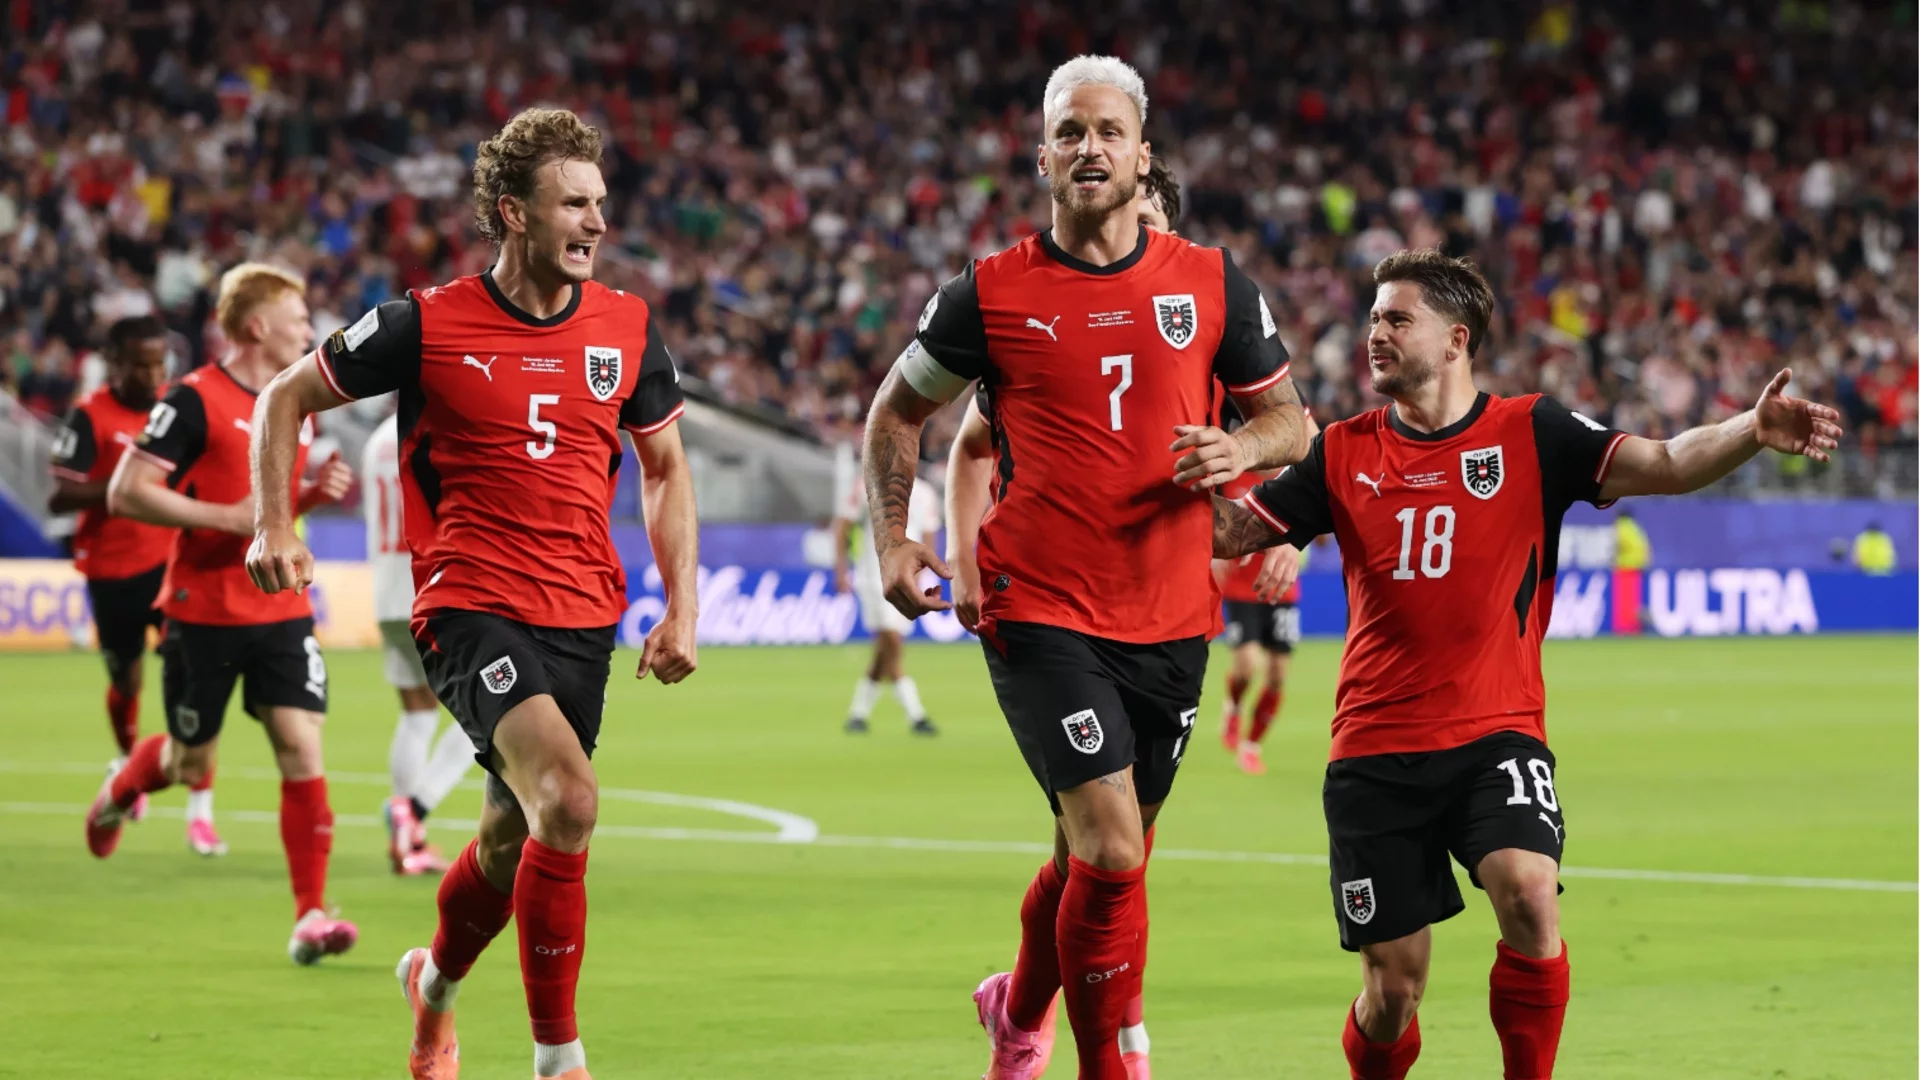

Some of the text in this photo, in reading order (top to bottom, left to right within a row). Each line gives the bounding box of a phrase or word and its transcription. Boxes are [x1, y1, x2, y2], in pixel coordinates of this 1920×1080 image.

[526, 393, 561, 459] 5
[1101, 354, 1133, 431] 7
[1393, 505, 1456, 580] 18
[1649, 567, 1819, 637] ULTRA
[1497, 757, 1558, 812] 18
